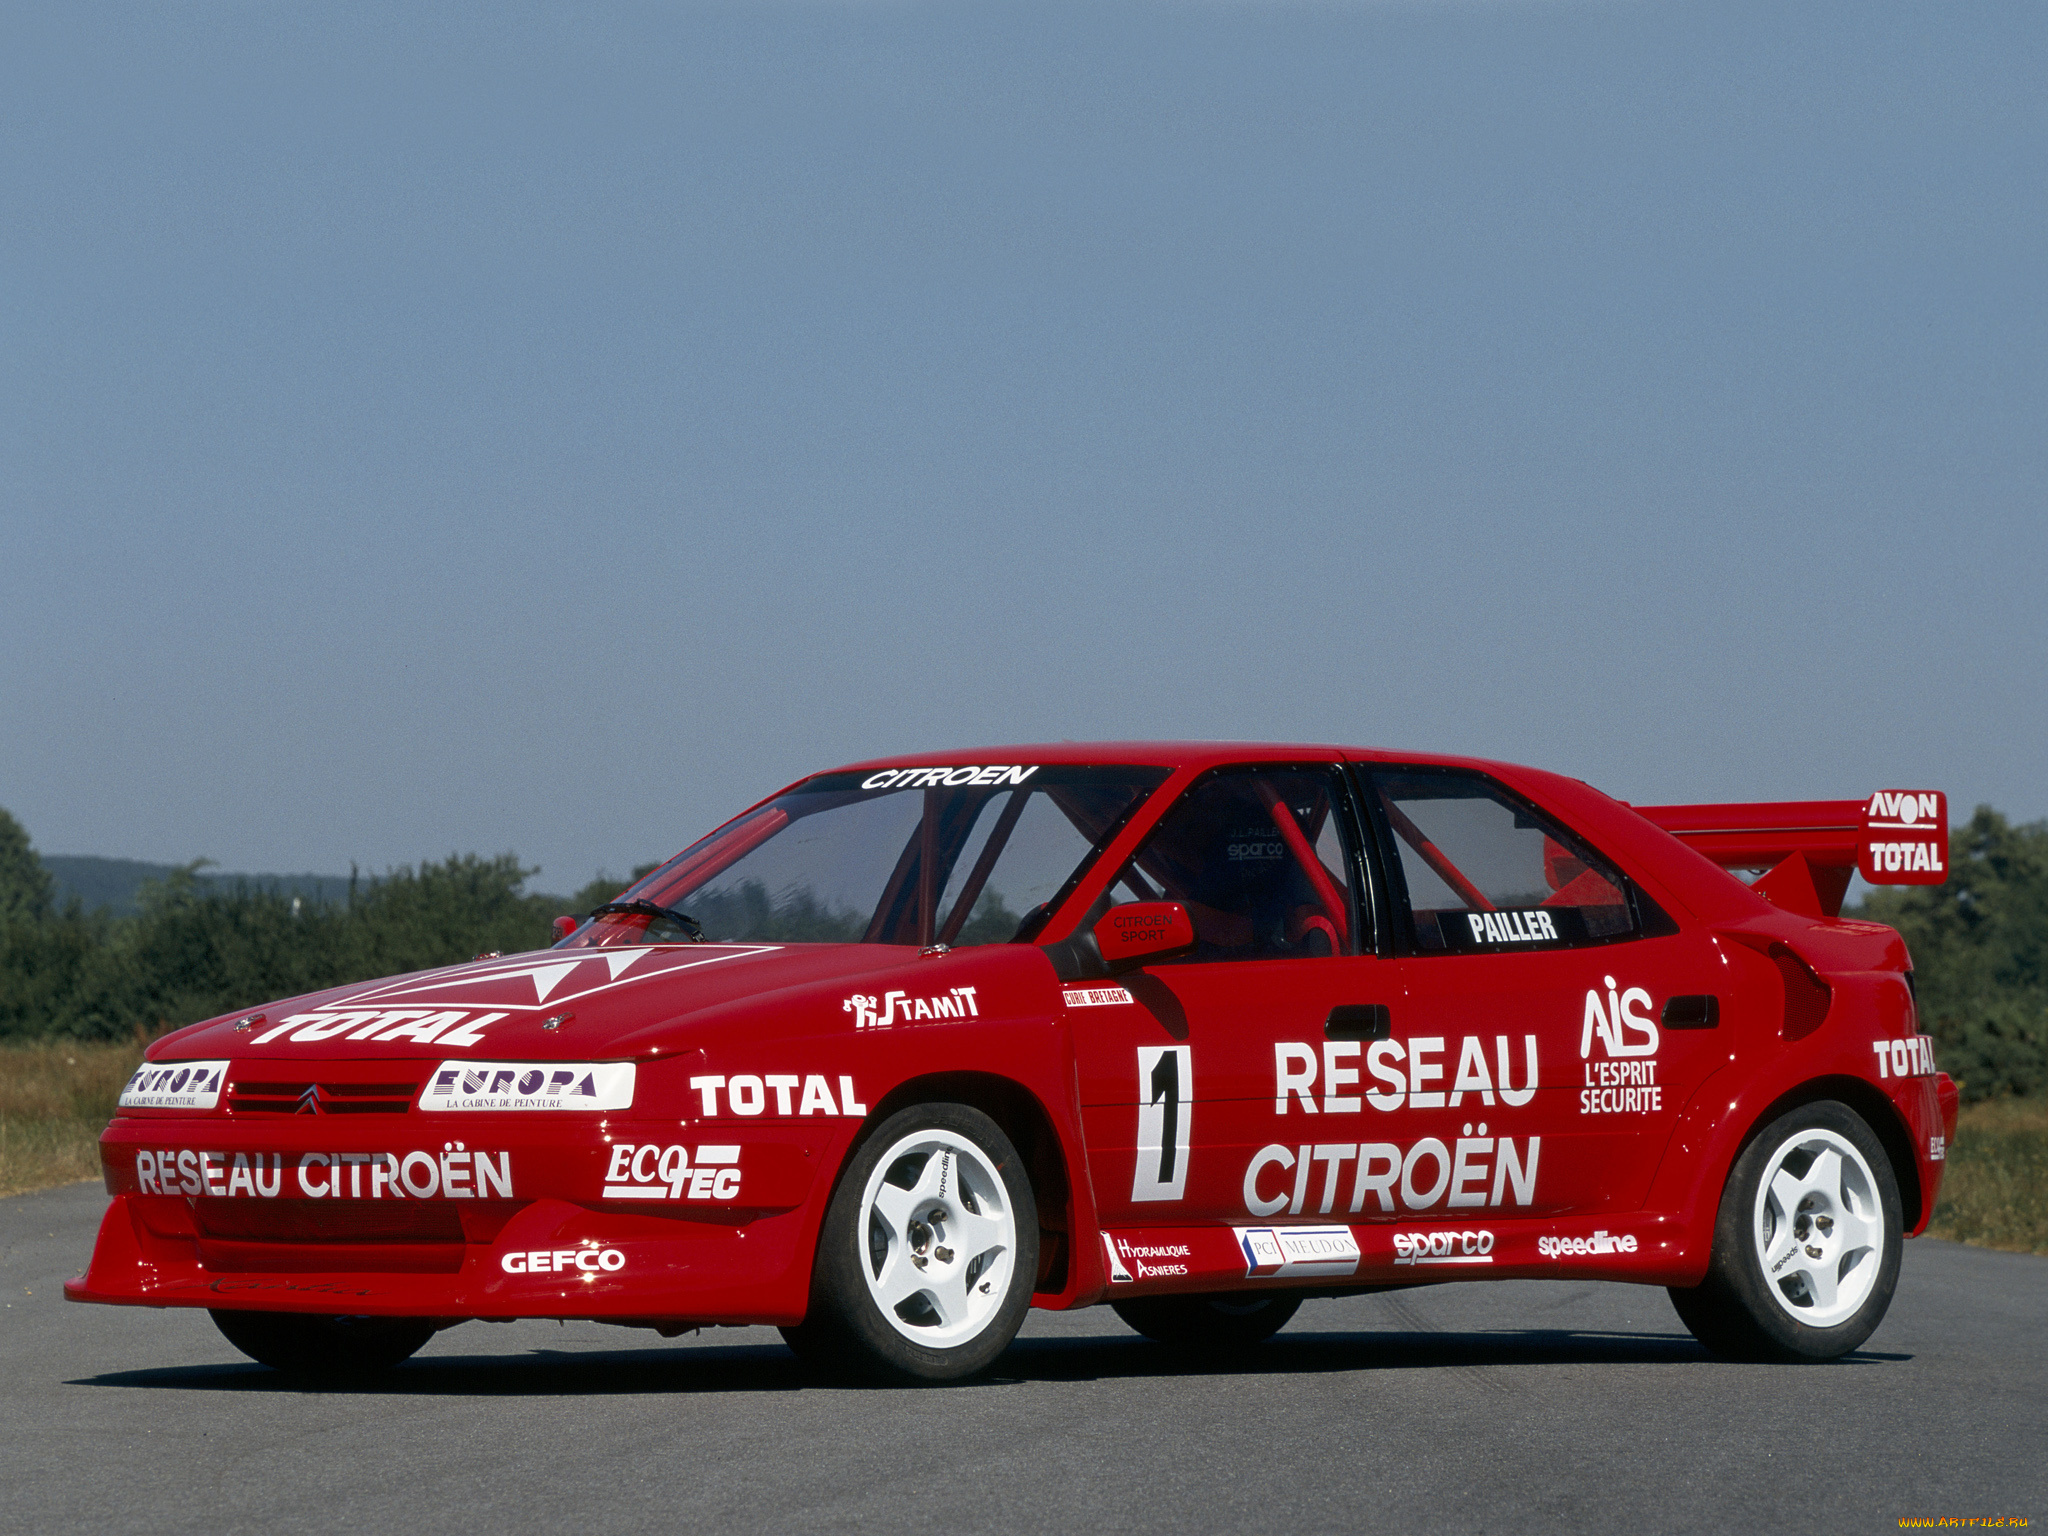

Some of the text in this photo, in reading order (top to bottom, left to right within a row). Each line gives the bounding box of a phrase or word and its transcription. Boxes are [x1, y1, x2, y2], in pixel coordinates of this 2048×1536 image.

[862, 766, 1039, 789] CITROEN
[1868, 792, 1937, 824] AVON
[1228, 842, 1283, 860] sparco
[1870, 843, 1943, 871] TOTAL
[1114, 914, 1172, 928] CITROEN
[1467, 911, 1558, 943] PAILLER
[1121, 930, 1165, 942] SPORT
[1087, 989, 1129, 1004] BRETAGNE
[250, 1010, 511, 1047] TOTAL
[1873, 1038, 1936, 1078] TOTAL
[124, 1068, 222, 1094] EUROPA
[432, 1069, 598, 1098] EUROPA
[1274, 1034, 1539, 1115] RESEAU
[1585, 1061, 1657, 1087] L'ESPRIT
[125, 1096, 196, 1106] LA CABINE DE PEINTURE
[446, 1099, 563, 1108] LA CABINE DE PEINTURE
[690, 1074, 867, 1117] TOTAL
[1580, 1087, 1662, 1114] SECURITE
[1150, 1050, 1178, 1184] 1
[136, 1142, 513, 1198] RESEAU CITROËN
[1243, 1122, 1541, 1217] CITROËN
[1117, 1239, 1191, 1258] HYDRAULIQUE
[1254, 1238, 1357, 1255] PCI MEUDON
[1393, 1230, 1494, 1265] sparco
[1538, 1231, 1638, 1259] speedline
[501, 1249, 625, 1273] GEFCO
[1137, 1259, 1188, 1279] ASNIERES
